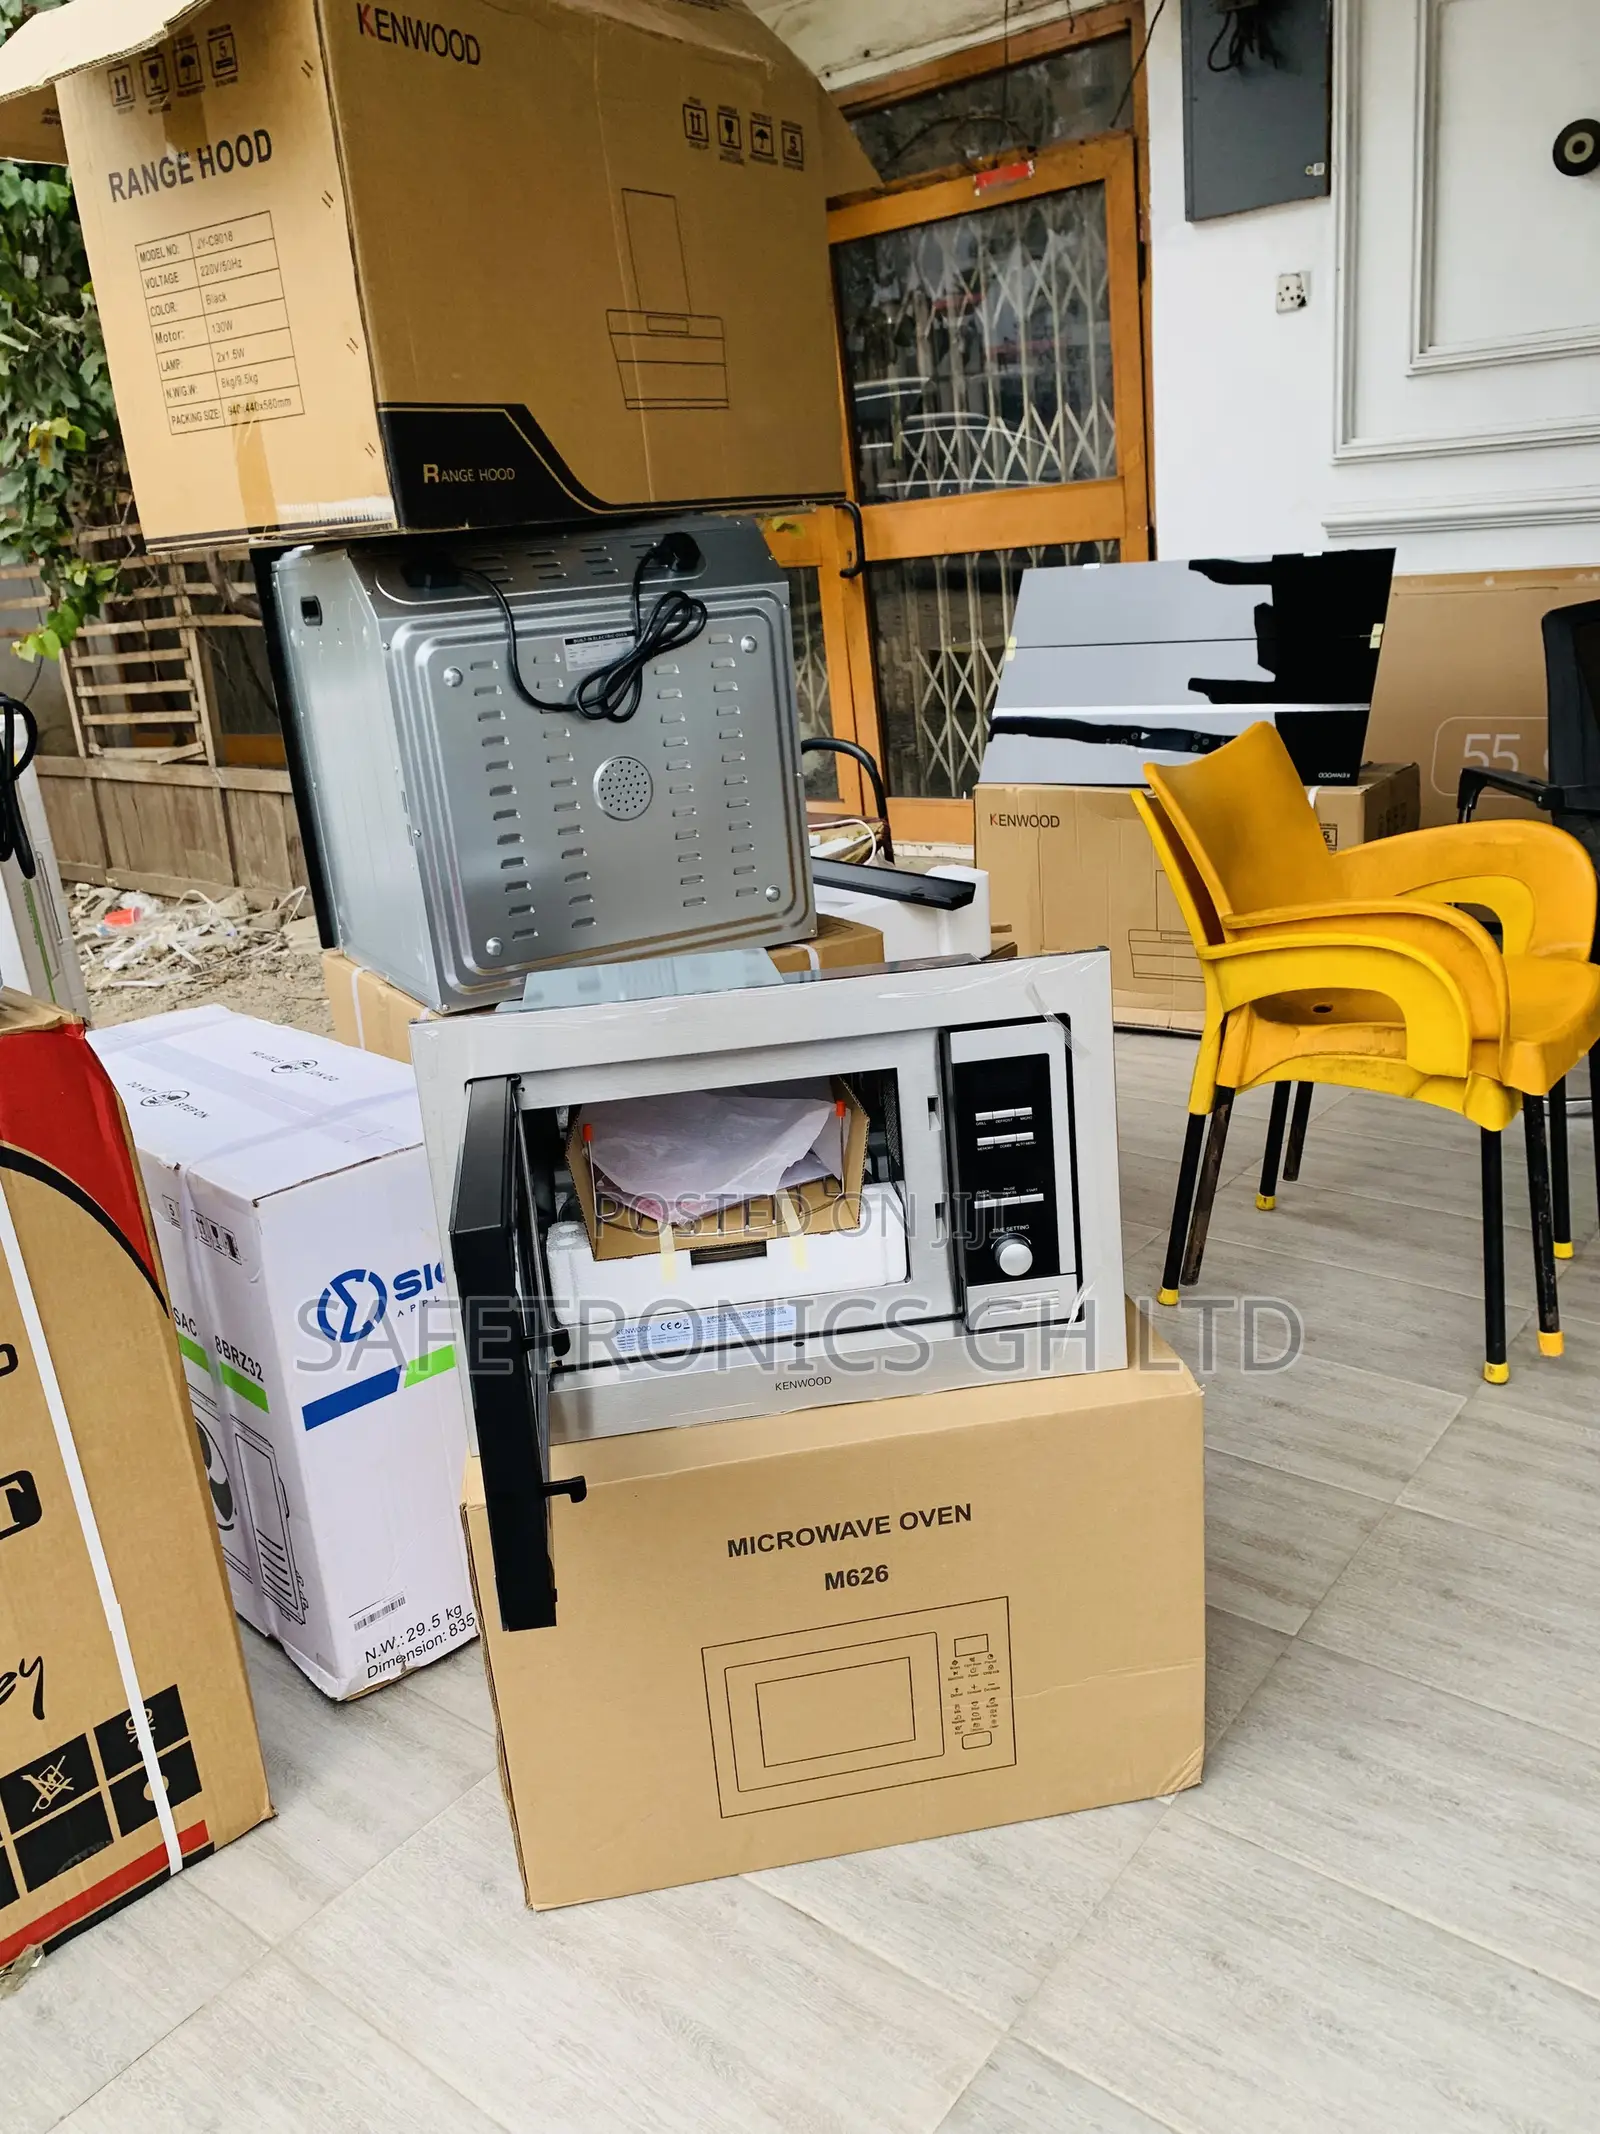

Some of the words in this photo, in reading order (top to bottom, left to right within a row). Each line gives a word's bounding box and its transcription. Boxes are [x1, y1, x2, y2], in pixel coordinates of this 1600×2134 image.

[357, 3, 481, 65] KENWOOD
[108, 151, 194, 202] RANGE
[197, 129, 272, 179] HOOD
[139, 247, 165, 263] MODEL
[205, 292, 228, 305] Black
[211, 320, 233, 334] 130W
[155, 329, 185, 344] Motor:
[171, 410, 203, 426] PACKING
[423, 463, 475, 484] RANGE
[478, 467, 515, 481] HOOD
[1463, 733, 1521, 773] 55
[989, 813, 1060, 828] KENWOOD
[1006, 1224, 1030, 1232] SETTING
[214, 1335, 265, 1383] 8BRZ32
[775, 1376, 832, 1391] KENWOOD
[727, 1515, 891, 1557] MICROWAVE
[899, 1503, 972, 1531] OVEN
[825, 1564, 889, 1590] M626
[445, 1604, 463, 1620] kg
[367, 1632, 447, 1679] Dimension:
[448, 1612, 475, 1637] 835
